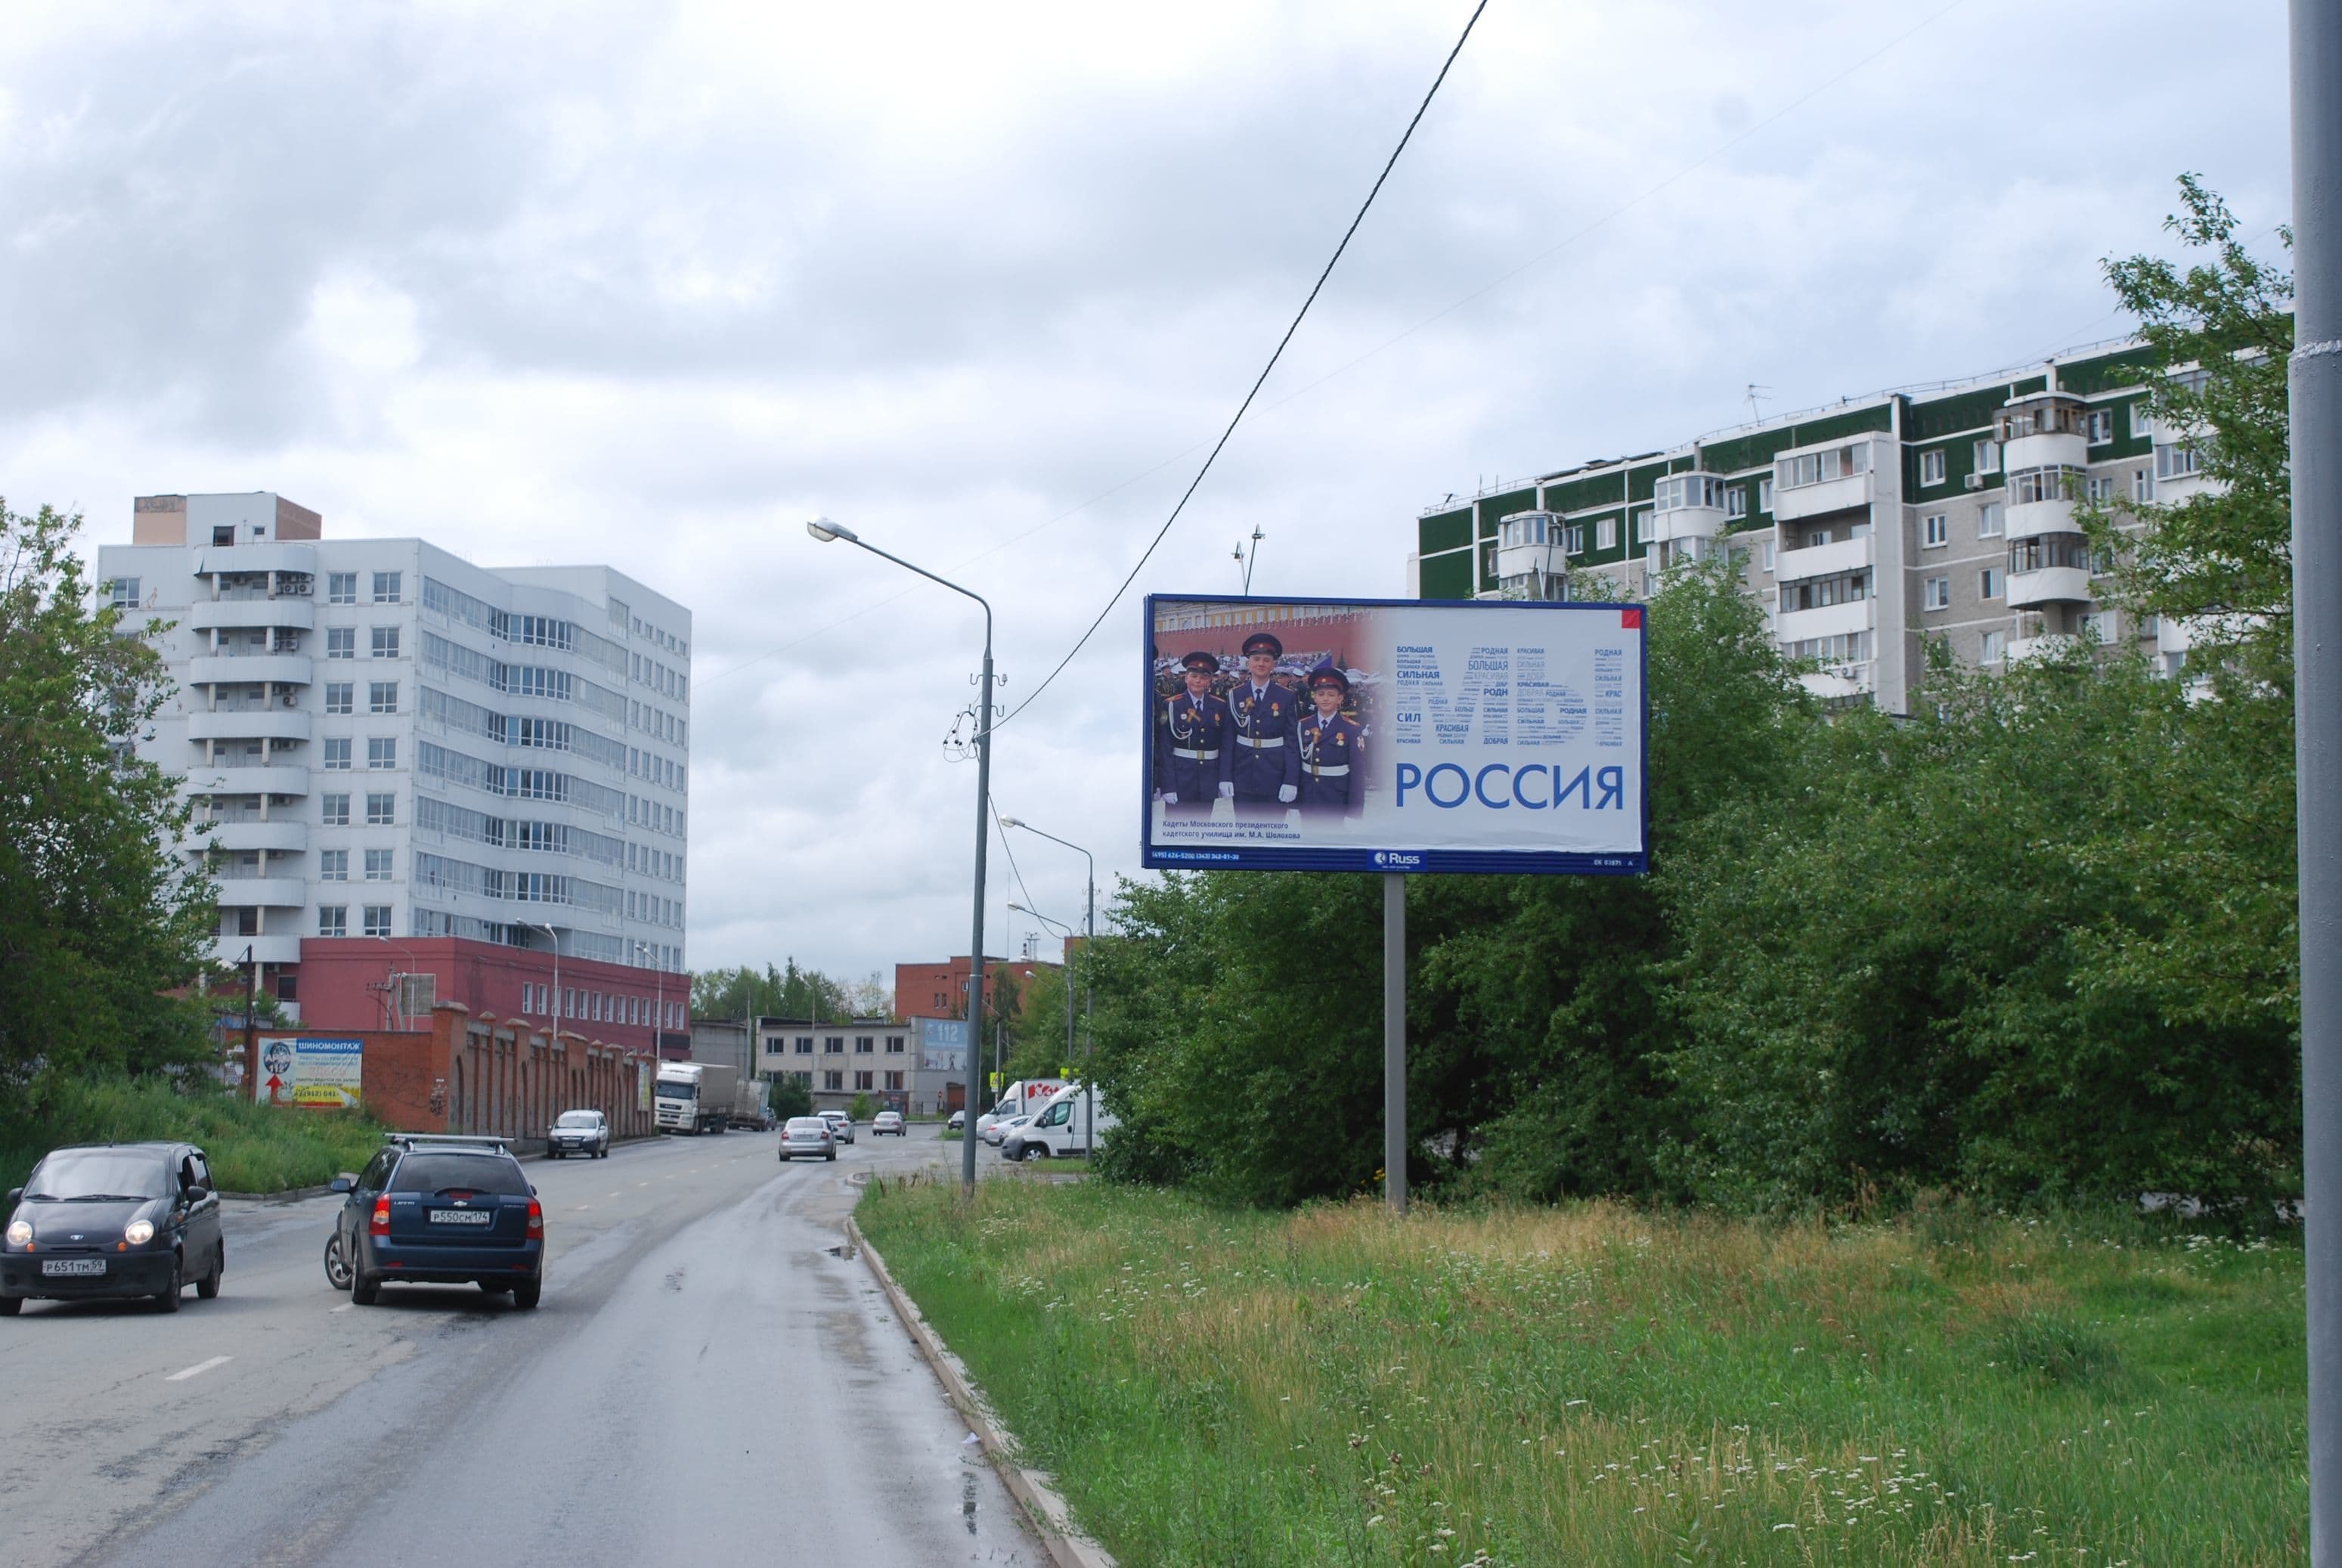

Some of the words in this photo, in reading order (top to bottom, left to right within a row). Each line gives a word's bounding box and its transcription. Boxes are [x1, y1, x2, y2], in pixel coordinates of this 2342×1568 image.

[1468, 661, 1508, 671] БОЛЬШАЯ
[1397, 671, 1440, 679] СИЛЬНАЯ
[1397, 713, 1421, 723] СИЛ
[1436, 724, 1469, 732] КРАСИВАЯ
[1396, 763, 1623, 810] РОССИЯ
[1389, 853, 1420, 863] Russ
[937, 1023, 958, 1042] 112
[299, 1042, 361, 1050] ШИНОМОНТАЖ
[47, 1262, 89, 1272] Р651ТМ
[92, 1260, 103, 1269] 59
